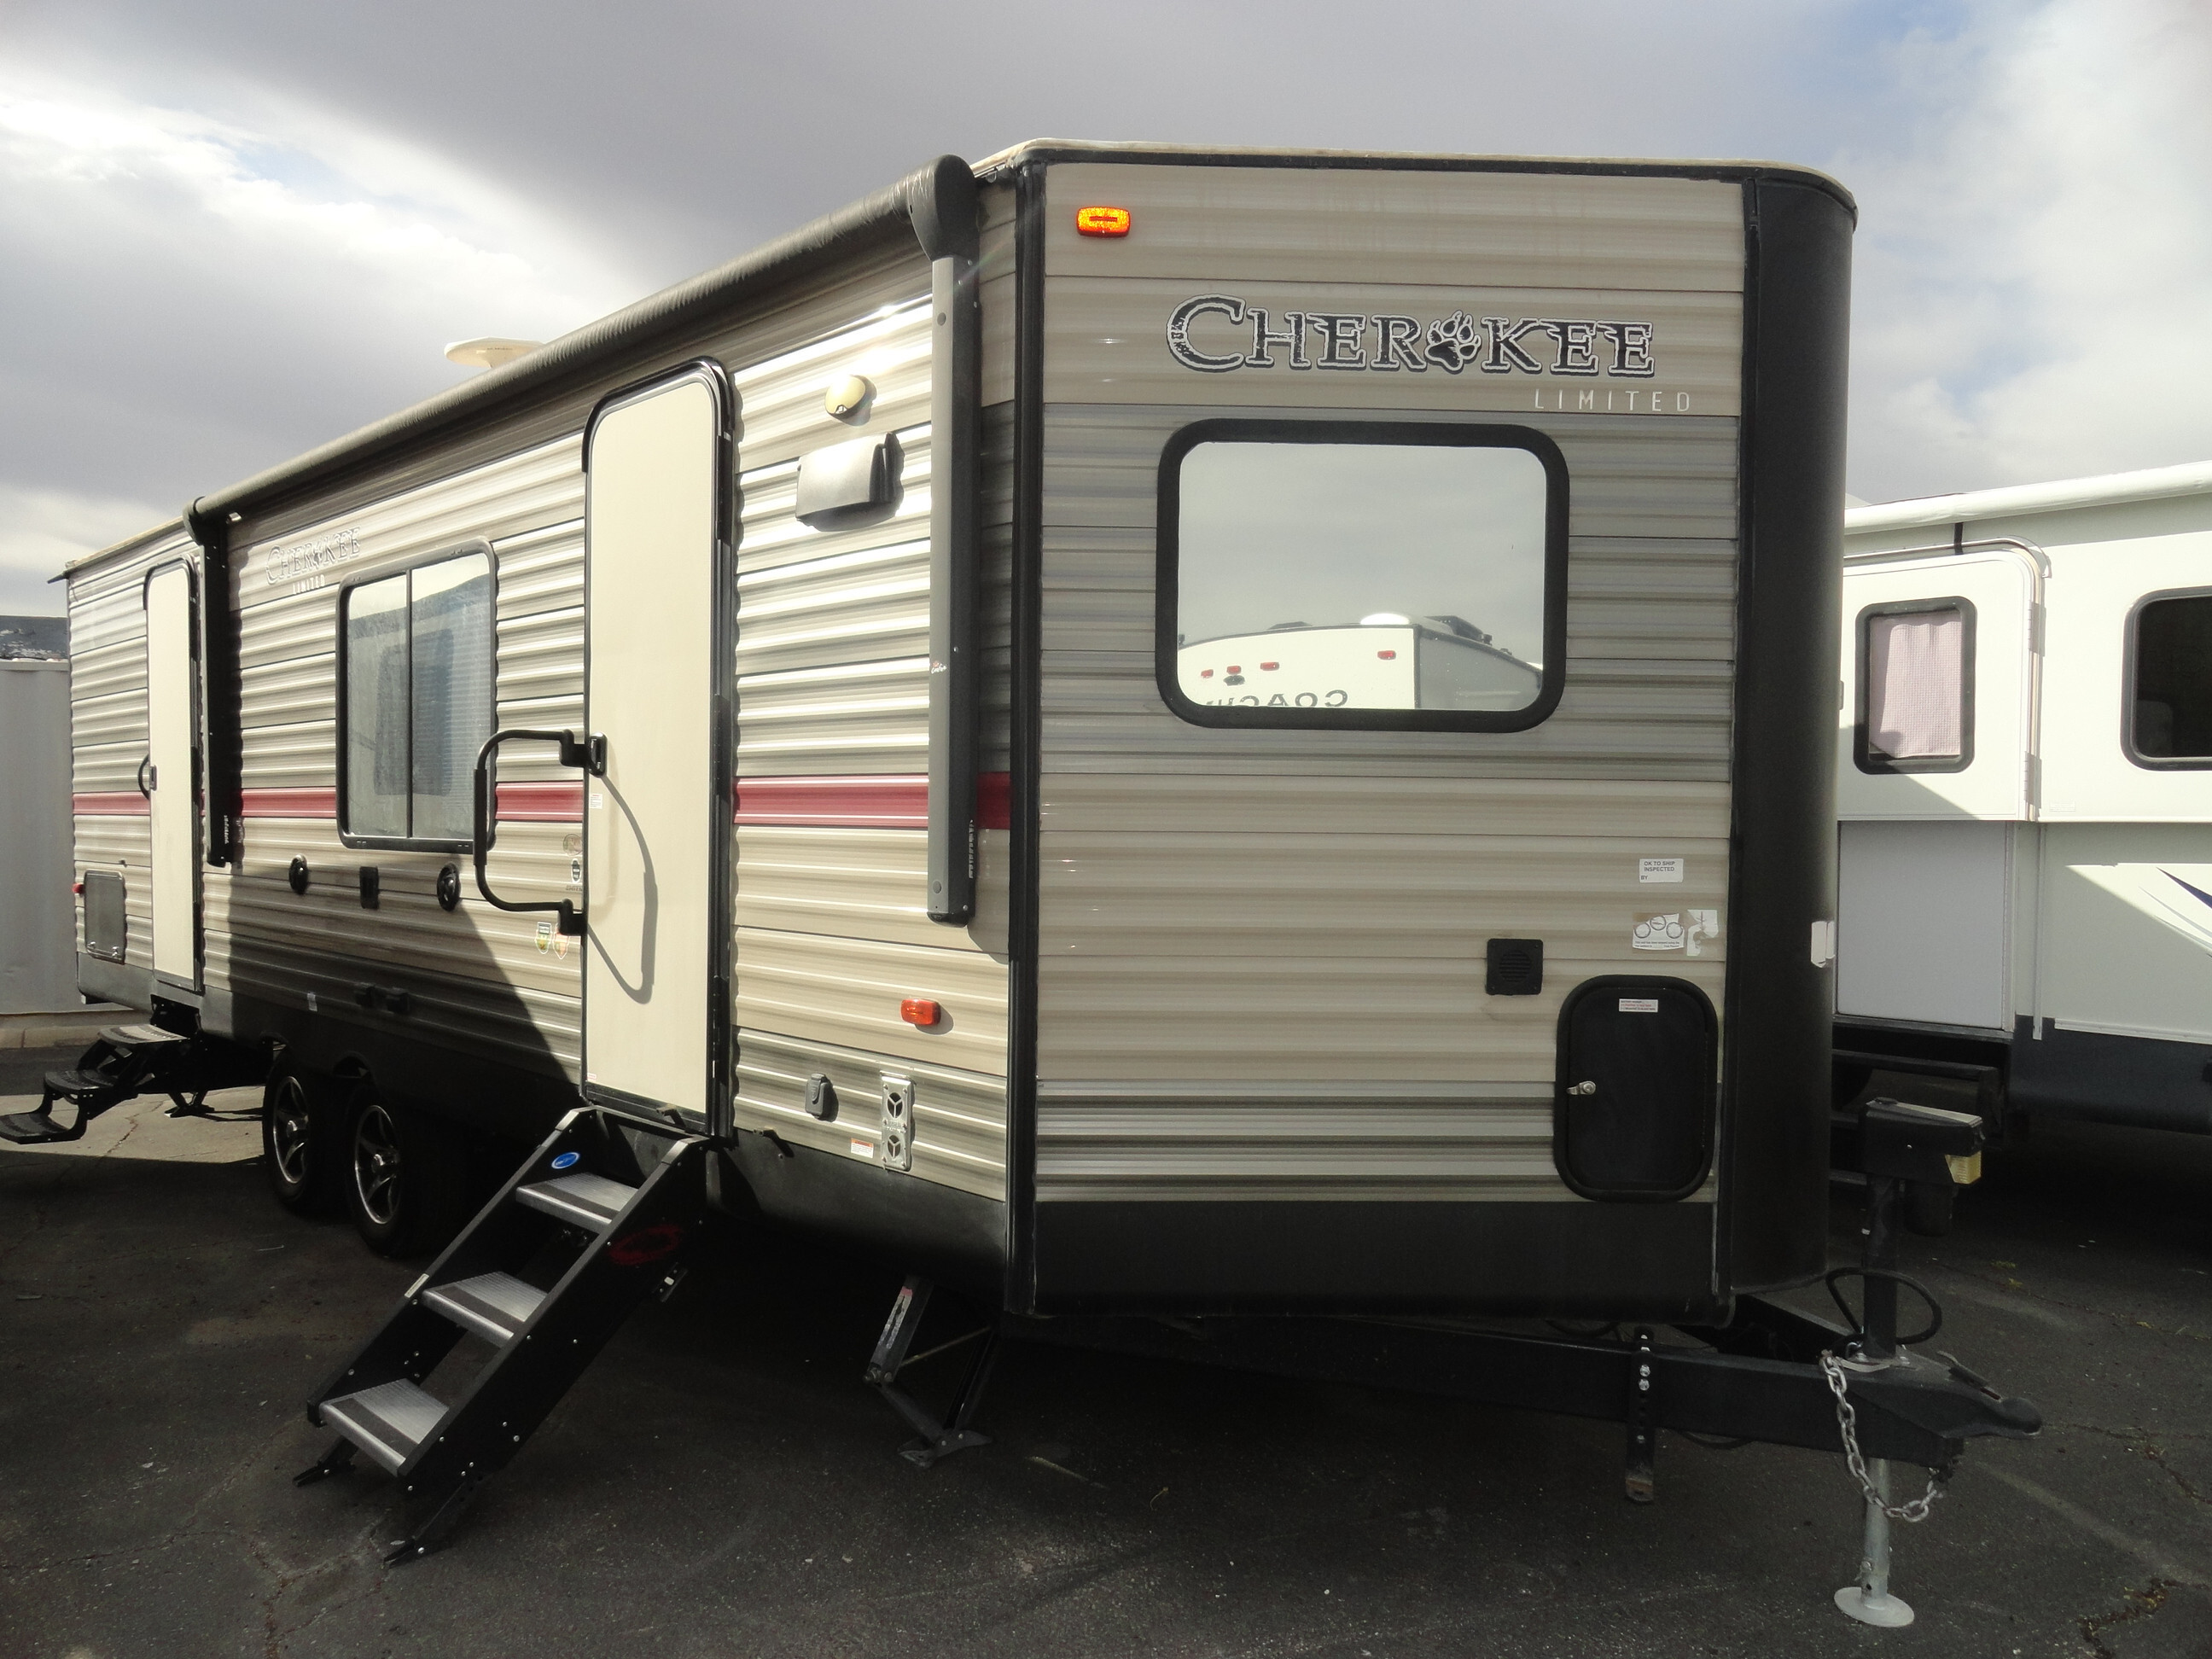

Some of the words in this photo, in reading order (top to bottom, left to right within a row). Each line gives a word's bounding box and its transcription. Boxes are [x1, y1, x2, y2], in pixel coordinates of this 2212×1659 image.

[1167, 293, 1656, 377] CHEROKEE
[1534, 388, 1691, 411] LIMITED
[293, 574, 326, 595] LIMITED
